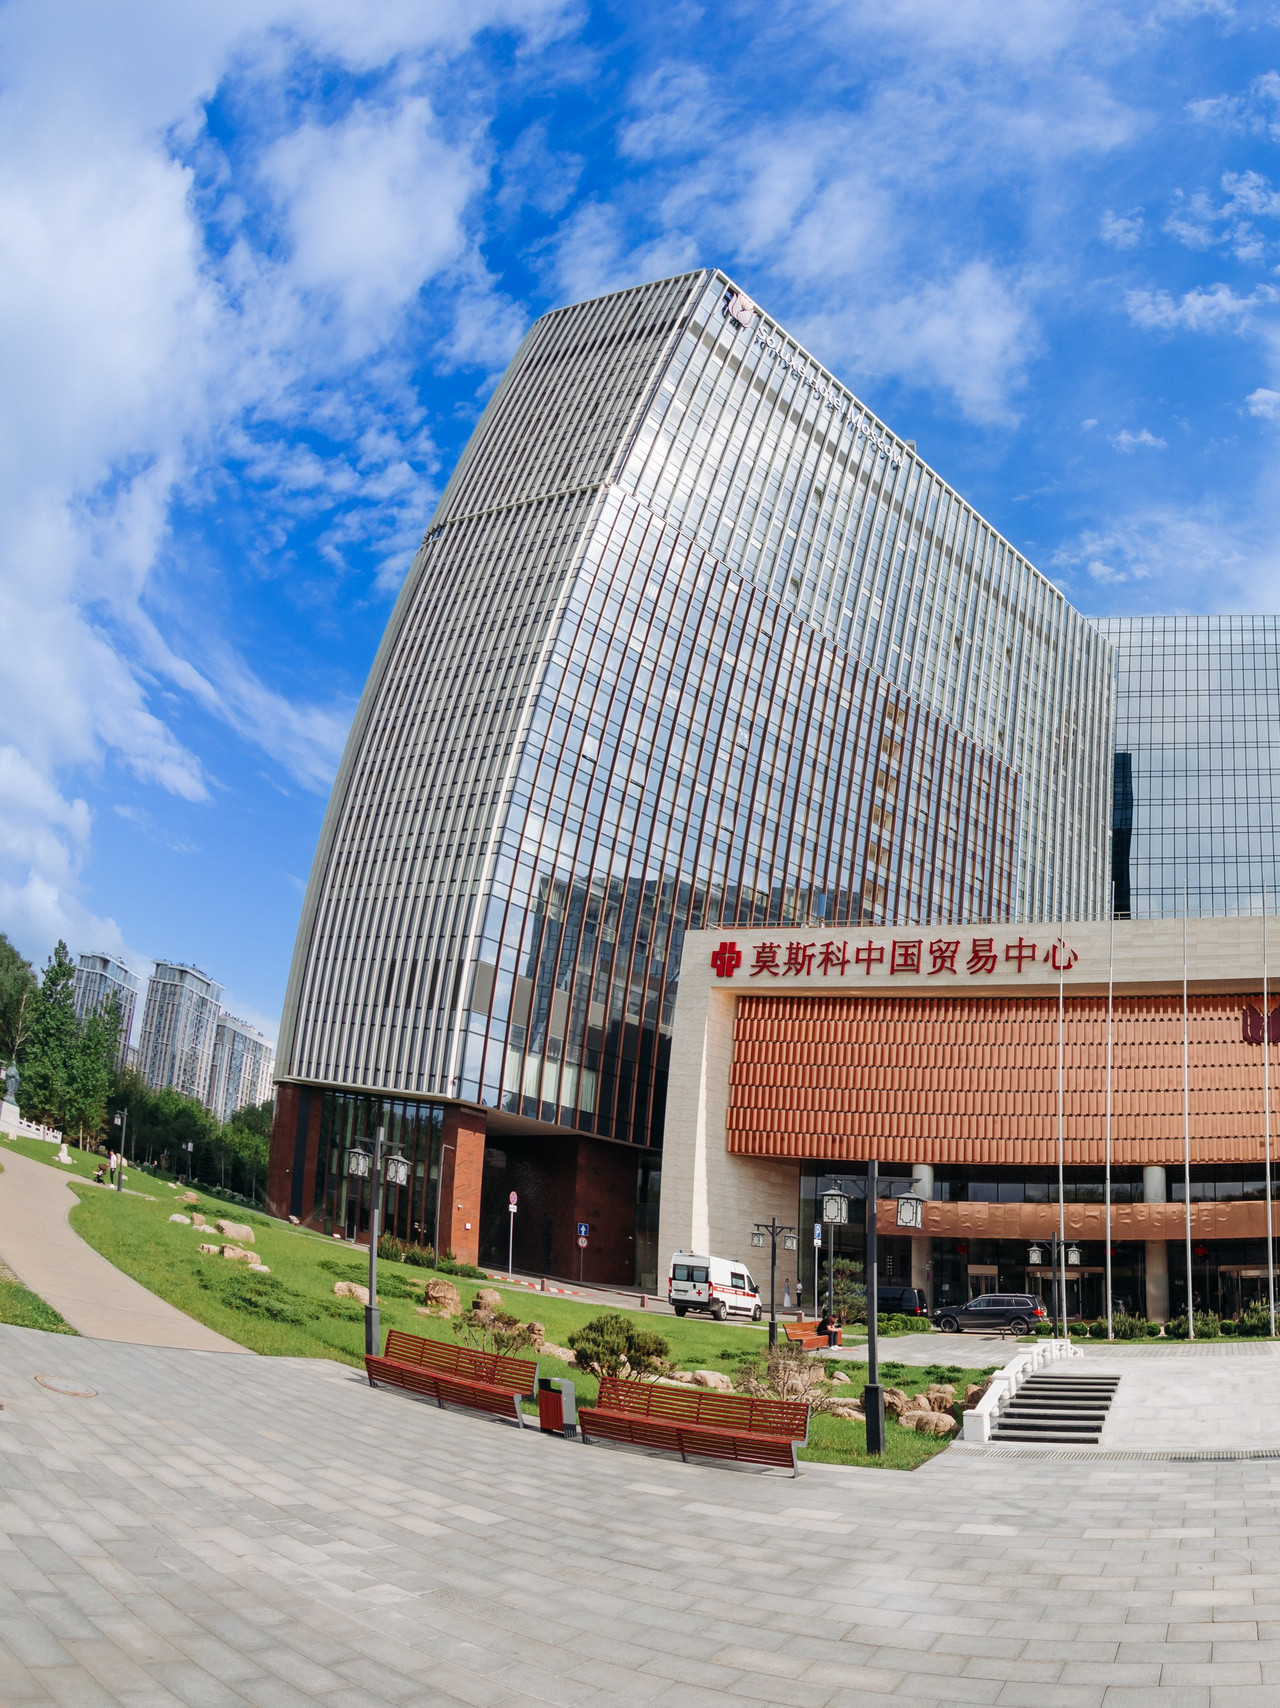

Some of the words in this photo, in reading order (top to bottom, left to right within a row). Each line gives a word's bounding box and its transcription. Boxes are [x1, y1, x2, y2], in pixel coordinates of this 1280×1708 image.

[757, 326, 806, 377] Soluxe
[808, 371, 847, 414] Hotel
[847, 405, 905, 468] Moscow
[749, 936, 1079, 976] 莫斯科中国贸易中心
